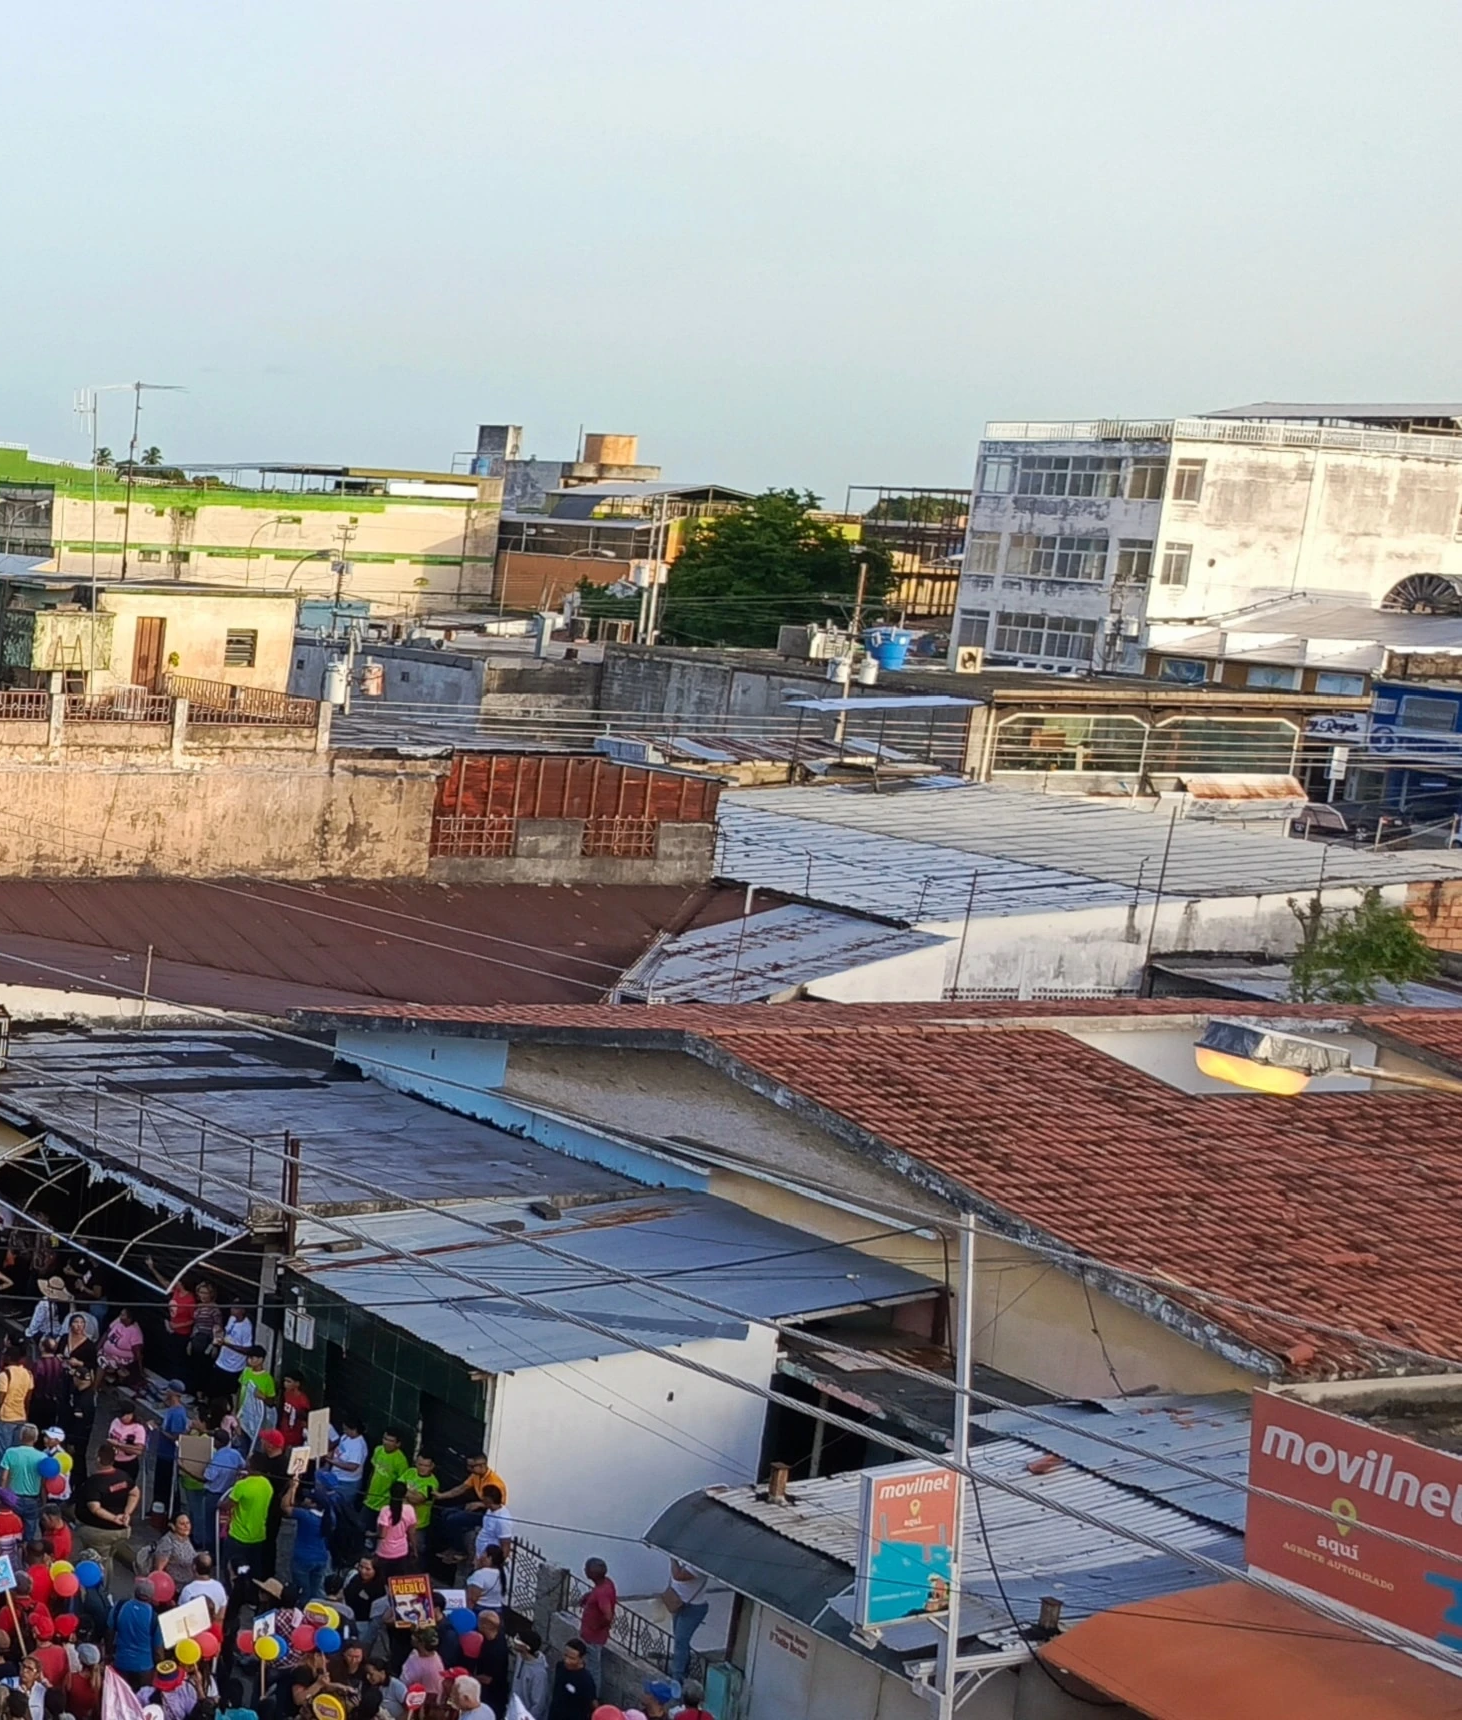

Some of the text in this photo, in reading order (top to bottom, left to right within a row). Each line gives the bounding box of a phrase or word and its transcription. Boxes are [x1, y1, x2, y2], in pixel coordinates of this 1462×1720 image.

[879, 1473, 950, 1500] movilnet
[1316, 1534, 1360, 1562] aquí
[1282, 1541, 1395, 1592] AGENTE AUTORIZADO
[392, 1582, 426, 1595] PUEBLO
